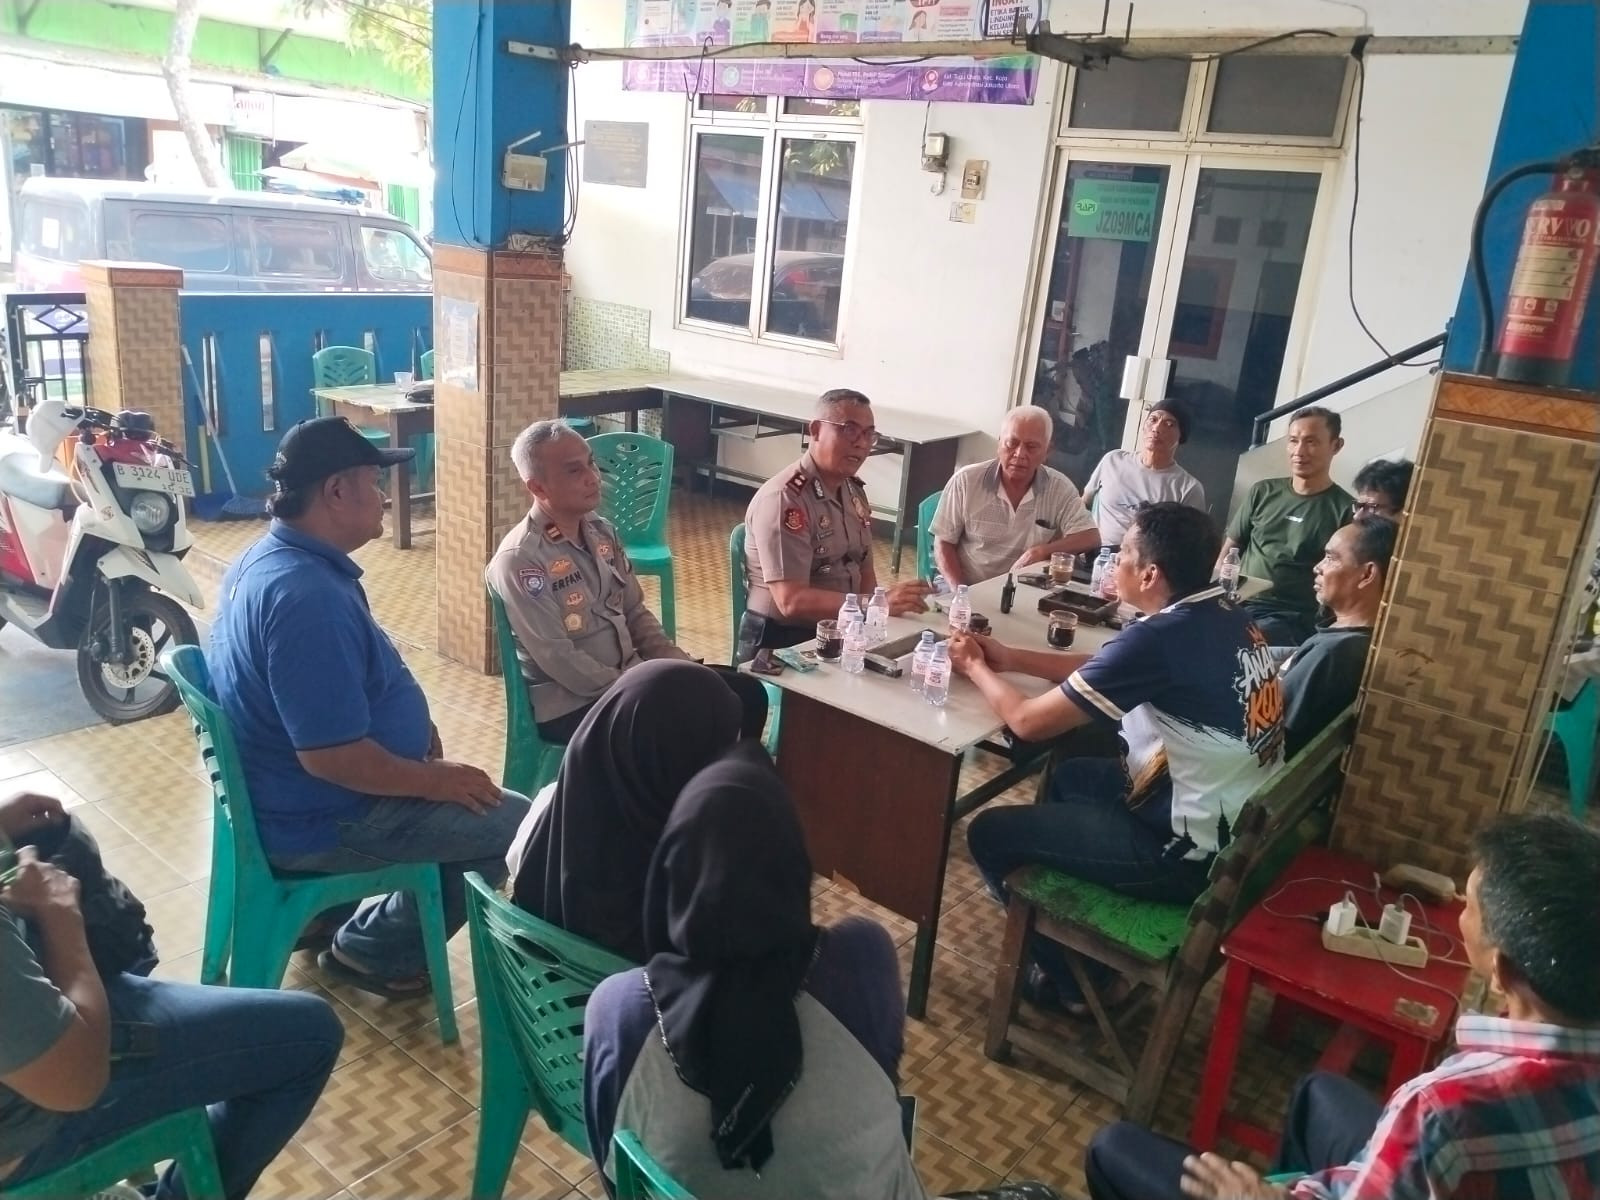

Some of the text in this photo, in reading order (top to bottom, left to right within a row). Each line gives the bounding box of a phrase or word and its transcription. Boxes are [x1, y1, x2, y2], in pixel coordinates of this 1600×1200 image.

[991, 6, 1030, 16] ETIKA BAUK
[1096, 210, 1152, 237] JZ09MCA
[117, 465, 126, 476] B
[131, 465, 161, 479] 3124
[552, 570, 582, 592] ERFAN
